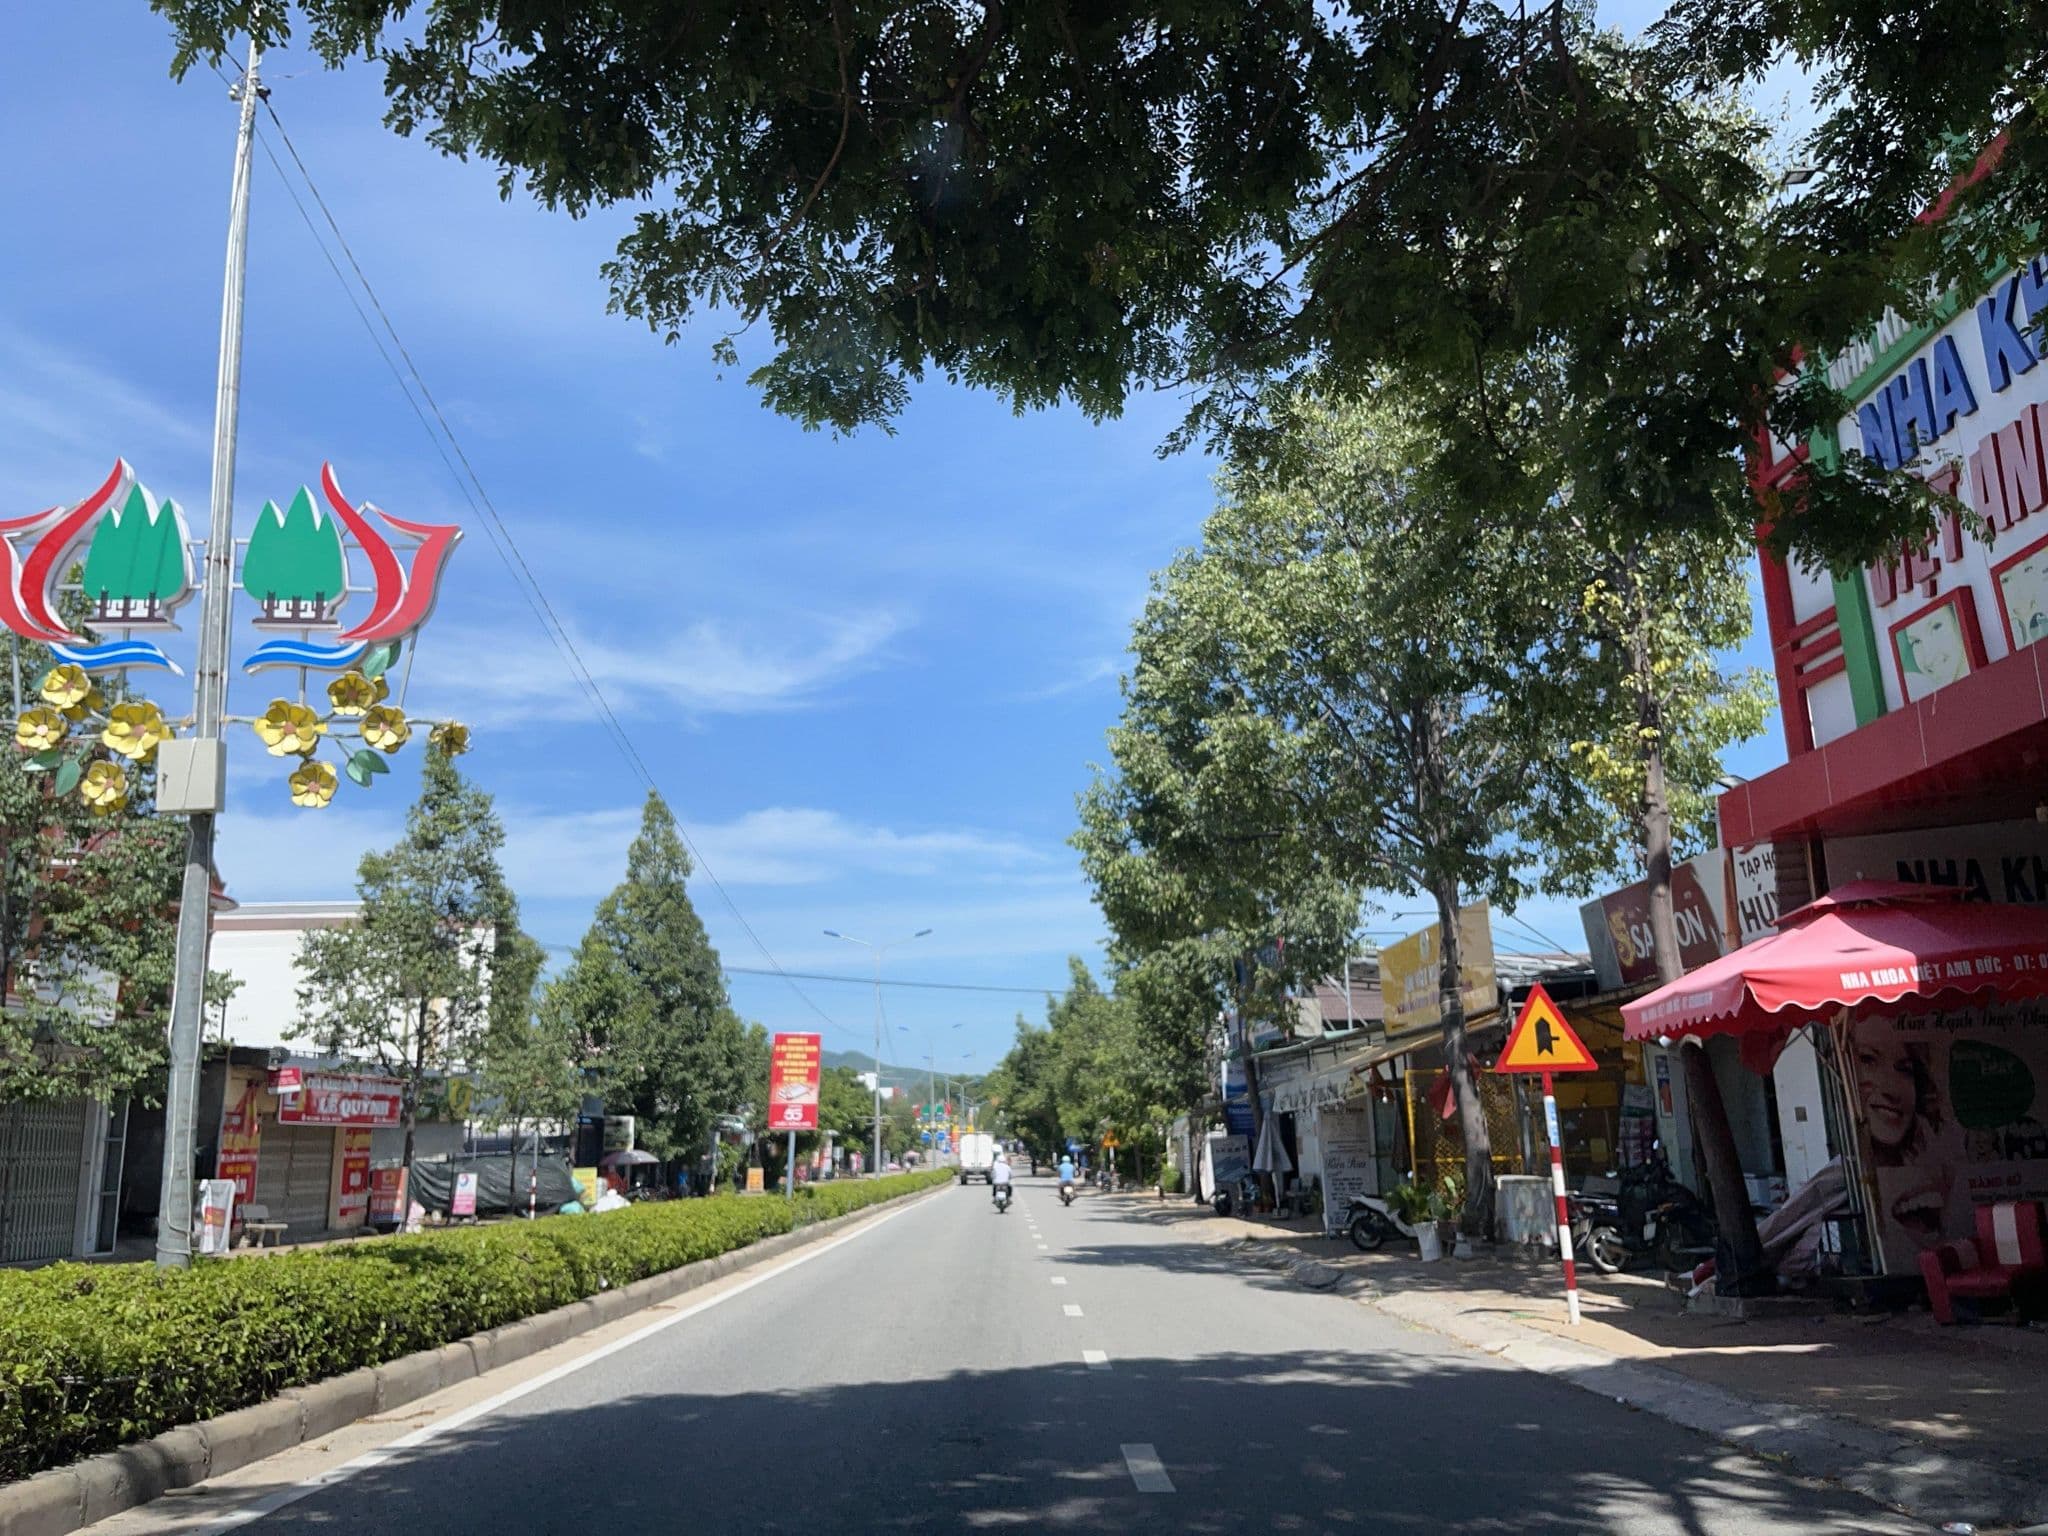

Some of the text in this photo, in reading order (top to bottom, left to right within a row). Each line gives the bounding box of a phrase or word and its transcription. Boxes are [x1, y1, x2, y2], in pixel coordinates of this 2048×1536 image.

[1858, 335, 1979, 472] NHA
[1969, 401, 2048, 532] AN
[1739, 857, 1762, 882] TẠP
[1840, 970, 1870, 990] NHA
[1871, 966, 1909, 986] KHOA
[1910, 960, 1941, 983] VIỆT
[1945, 957, 1973, 976] ANH
